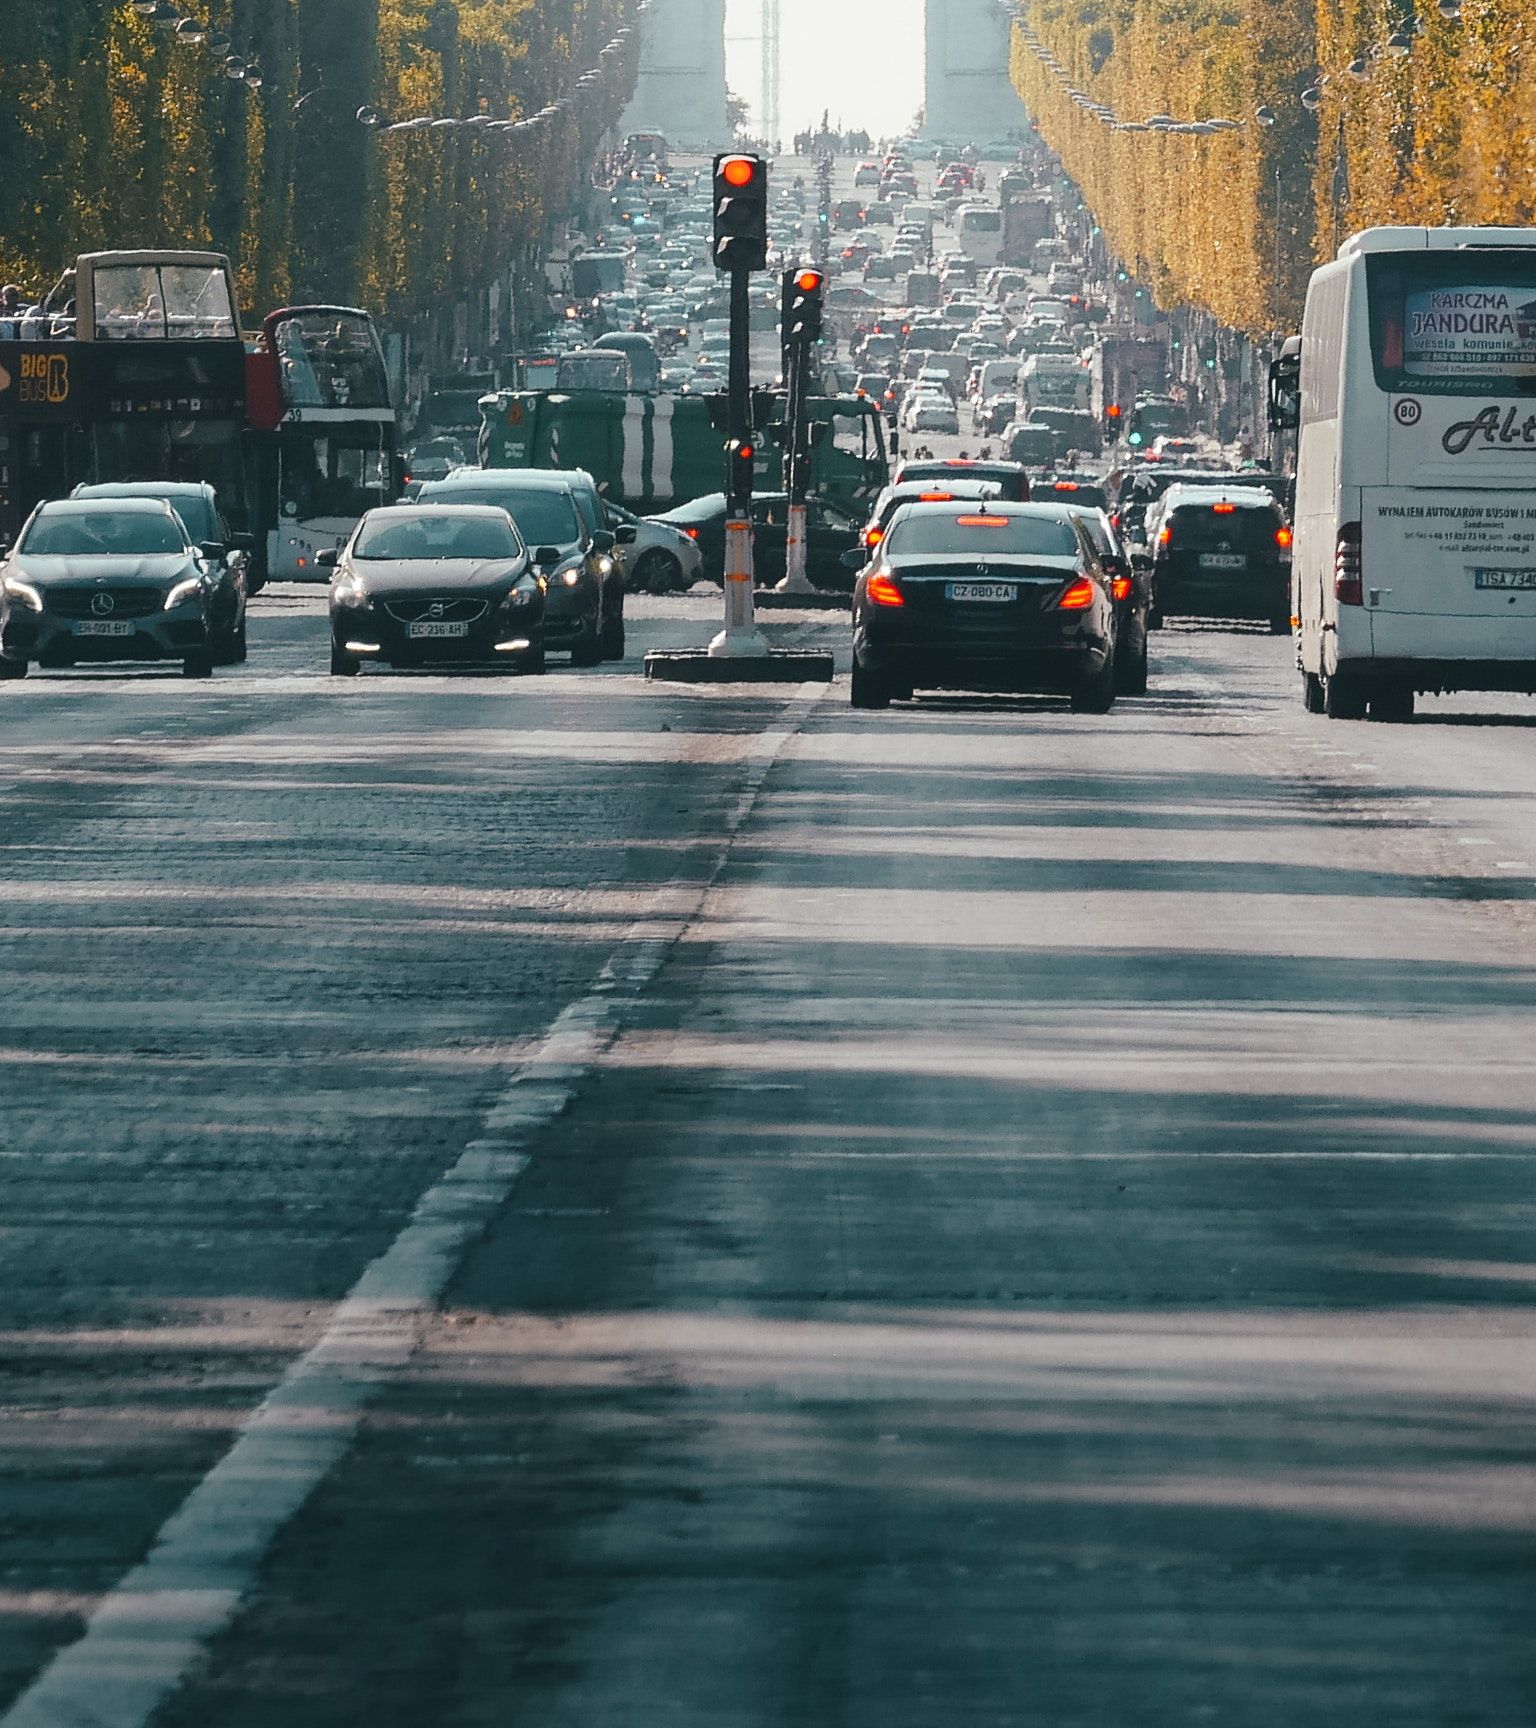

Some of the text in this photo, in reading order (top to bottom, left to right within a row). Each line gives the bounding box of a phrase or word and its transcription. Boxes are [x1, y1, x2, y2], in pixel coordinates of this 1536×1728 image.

[1431, 293, 1509, 309] KARCZMA
[1412, 313, 1515, 336] JANDURA
[1415, 338, 1456, 350] wesela
[20, 354, 47, 378] BIG
[19, 379, 47, 402] BUS
[288, 408, 303, 421] 39
[1400, 406, 1416, 418] 80
[1377, 506, 1424, 518] WYNAJEM
[1425, 506, 1484, 519] AUTOKARÓW
[1485, 506, 1519, 519] BUSÓW
